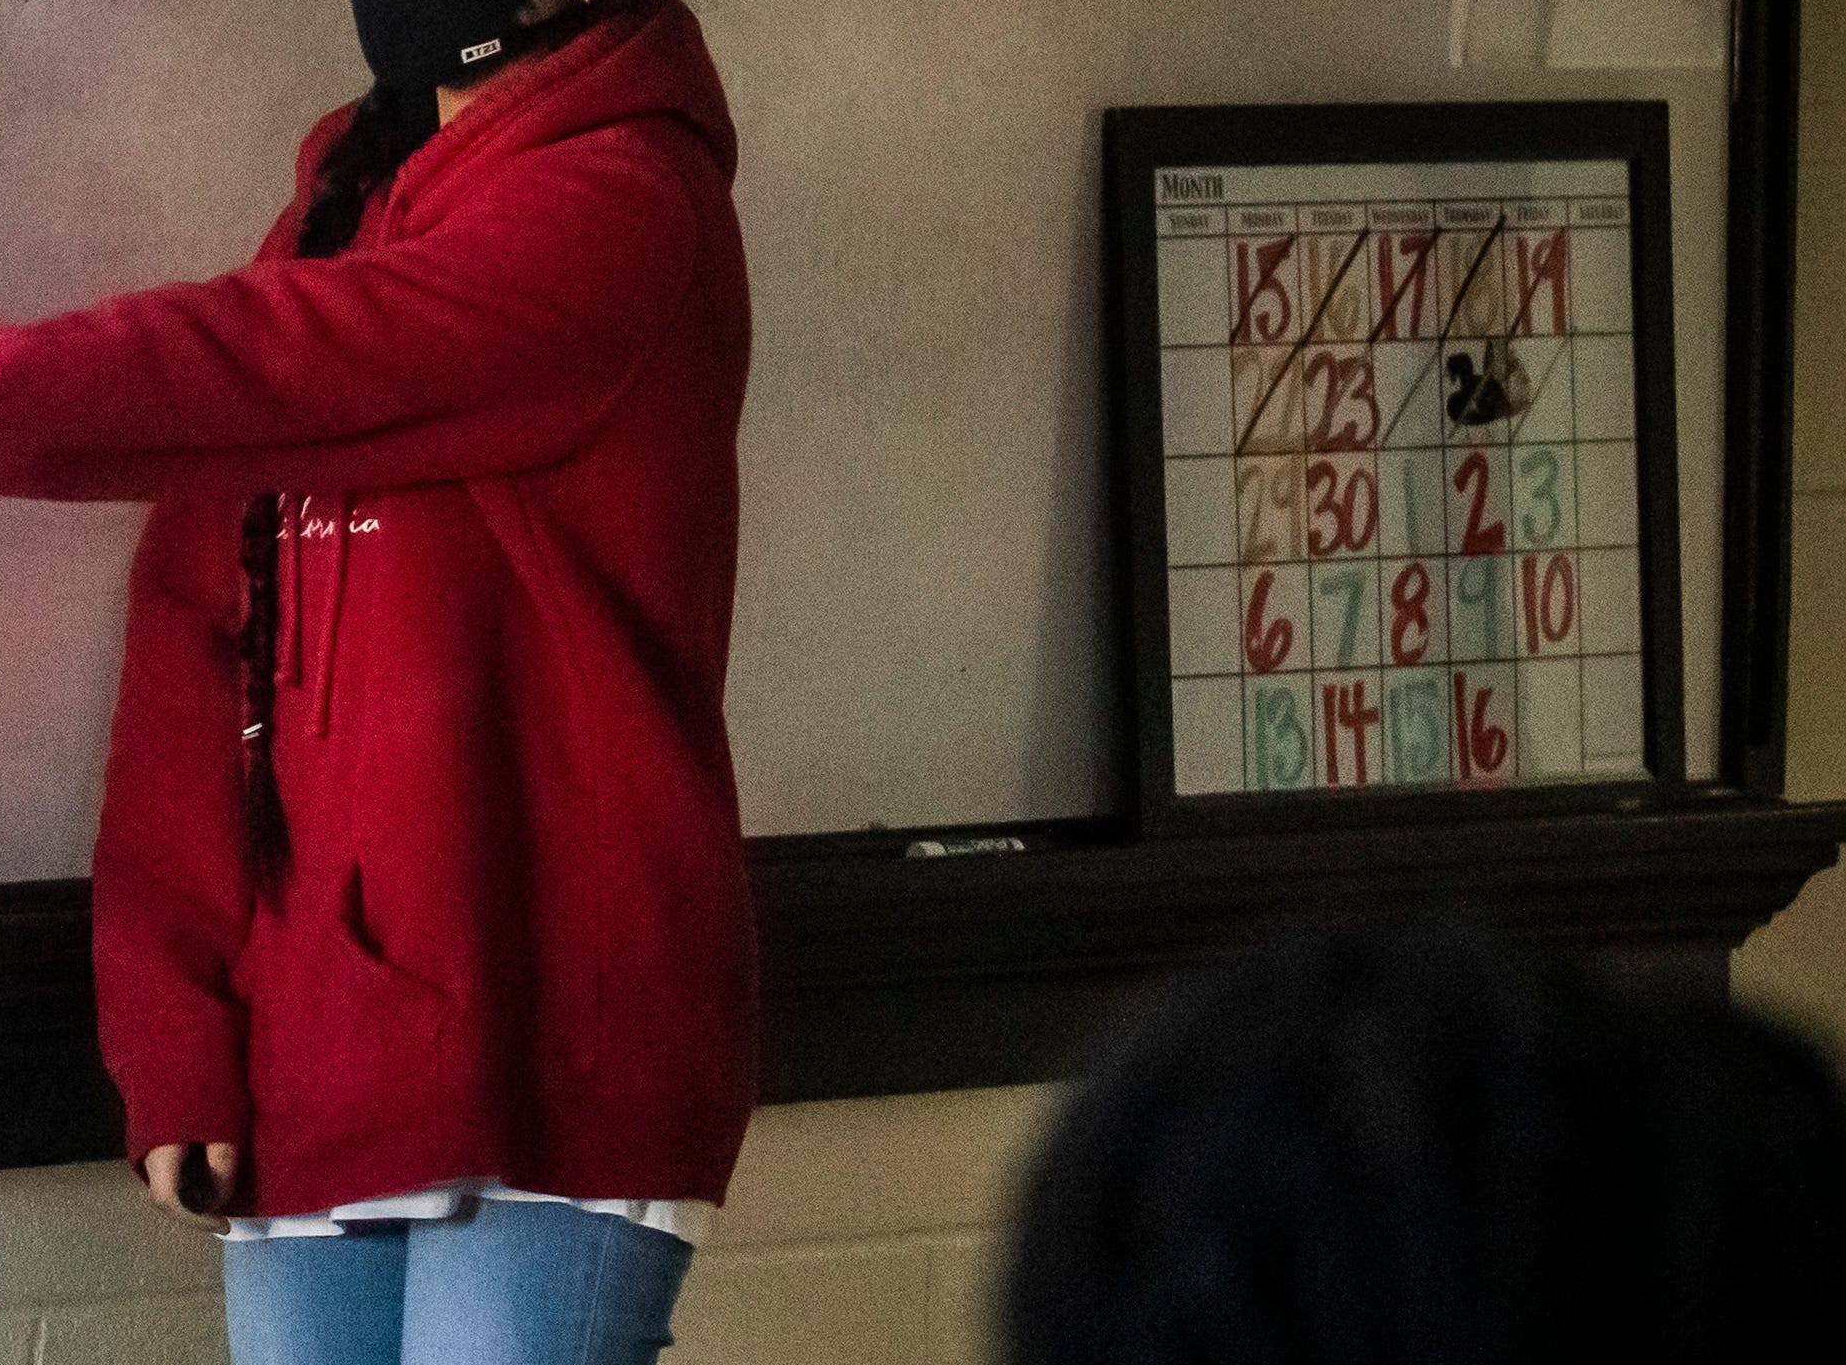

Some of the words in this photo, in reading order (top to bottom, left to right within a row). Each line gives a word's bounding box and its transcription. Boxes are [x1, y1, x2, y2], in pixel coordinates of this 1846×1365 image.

[1162, 174, 1223, 200] MONTH
[1305, 351, 1380, 452] 23
[1308, 460, 1379, 556] 30
[1454, 451, 1505, 556] 2
[1520, 450, 1559, 547] 3
[1246, 569, 1293, 673] 6
[1320, 569, 1364, 667] 7
[1391, 562, 1429, 667] 8
[1459, 557, 1497, 660] 9
[1523, 553, 1573, 656] 10
[1323, 681, 1379, 784] 14
[1454, 672, 1507, 781] 16
